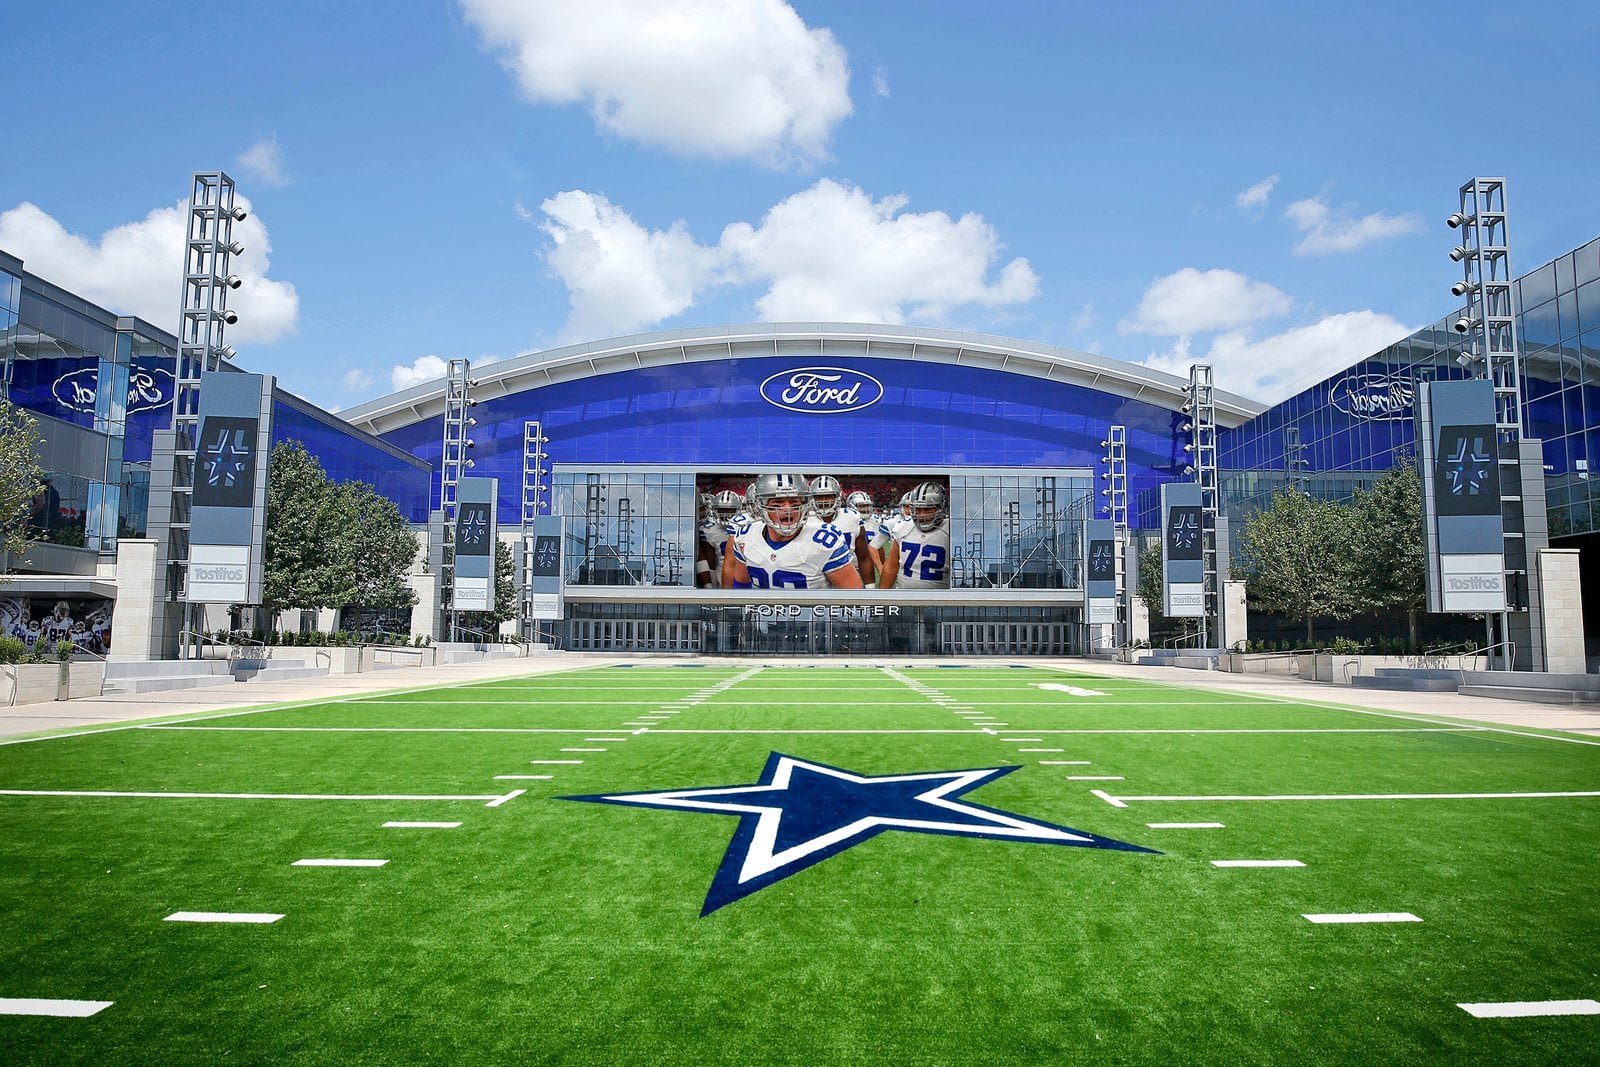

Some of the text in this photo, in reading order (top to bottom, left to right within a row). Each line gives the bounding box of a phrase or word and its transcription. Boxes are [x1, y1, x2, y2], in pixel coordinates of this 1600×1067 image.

[782, 373, 861, 405] Ford
[901, 543, 947, 581] 72
[745, 604, 900, 616] FORD CENTER
